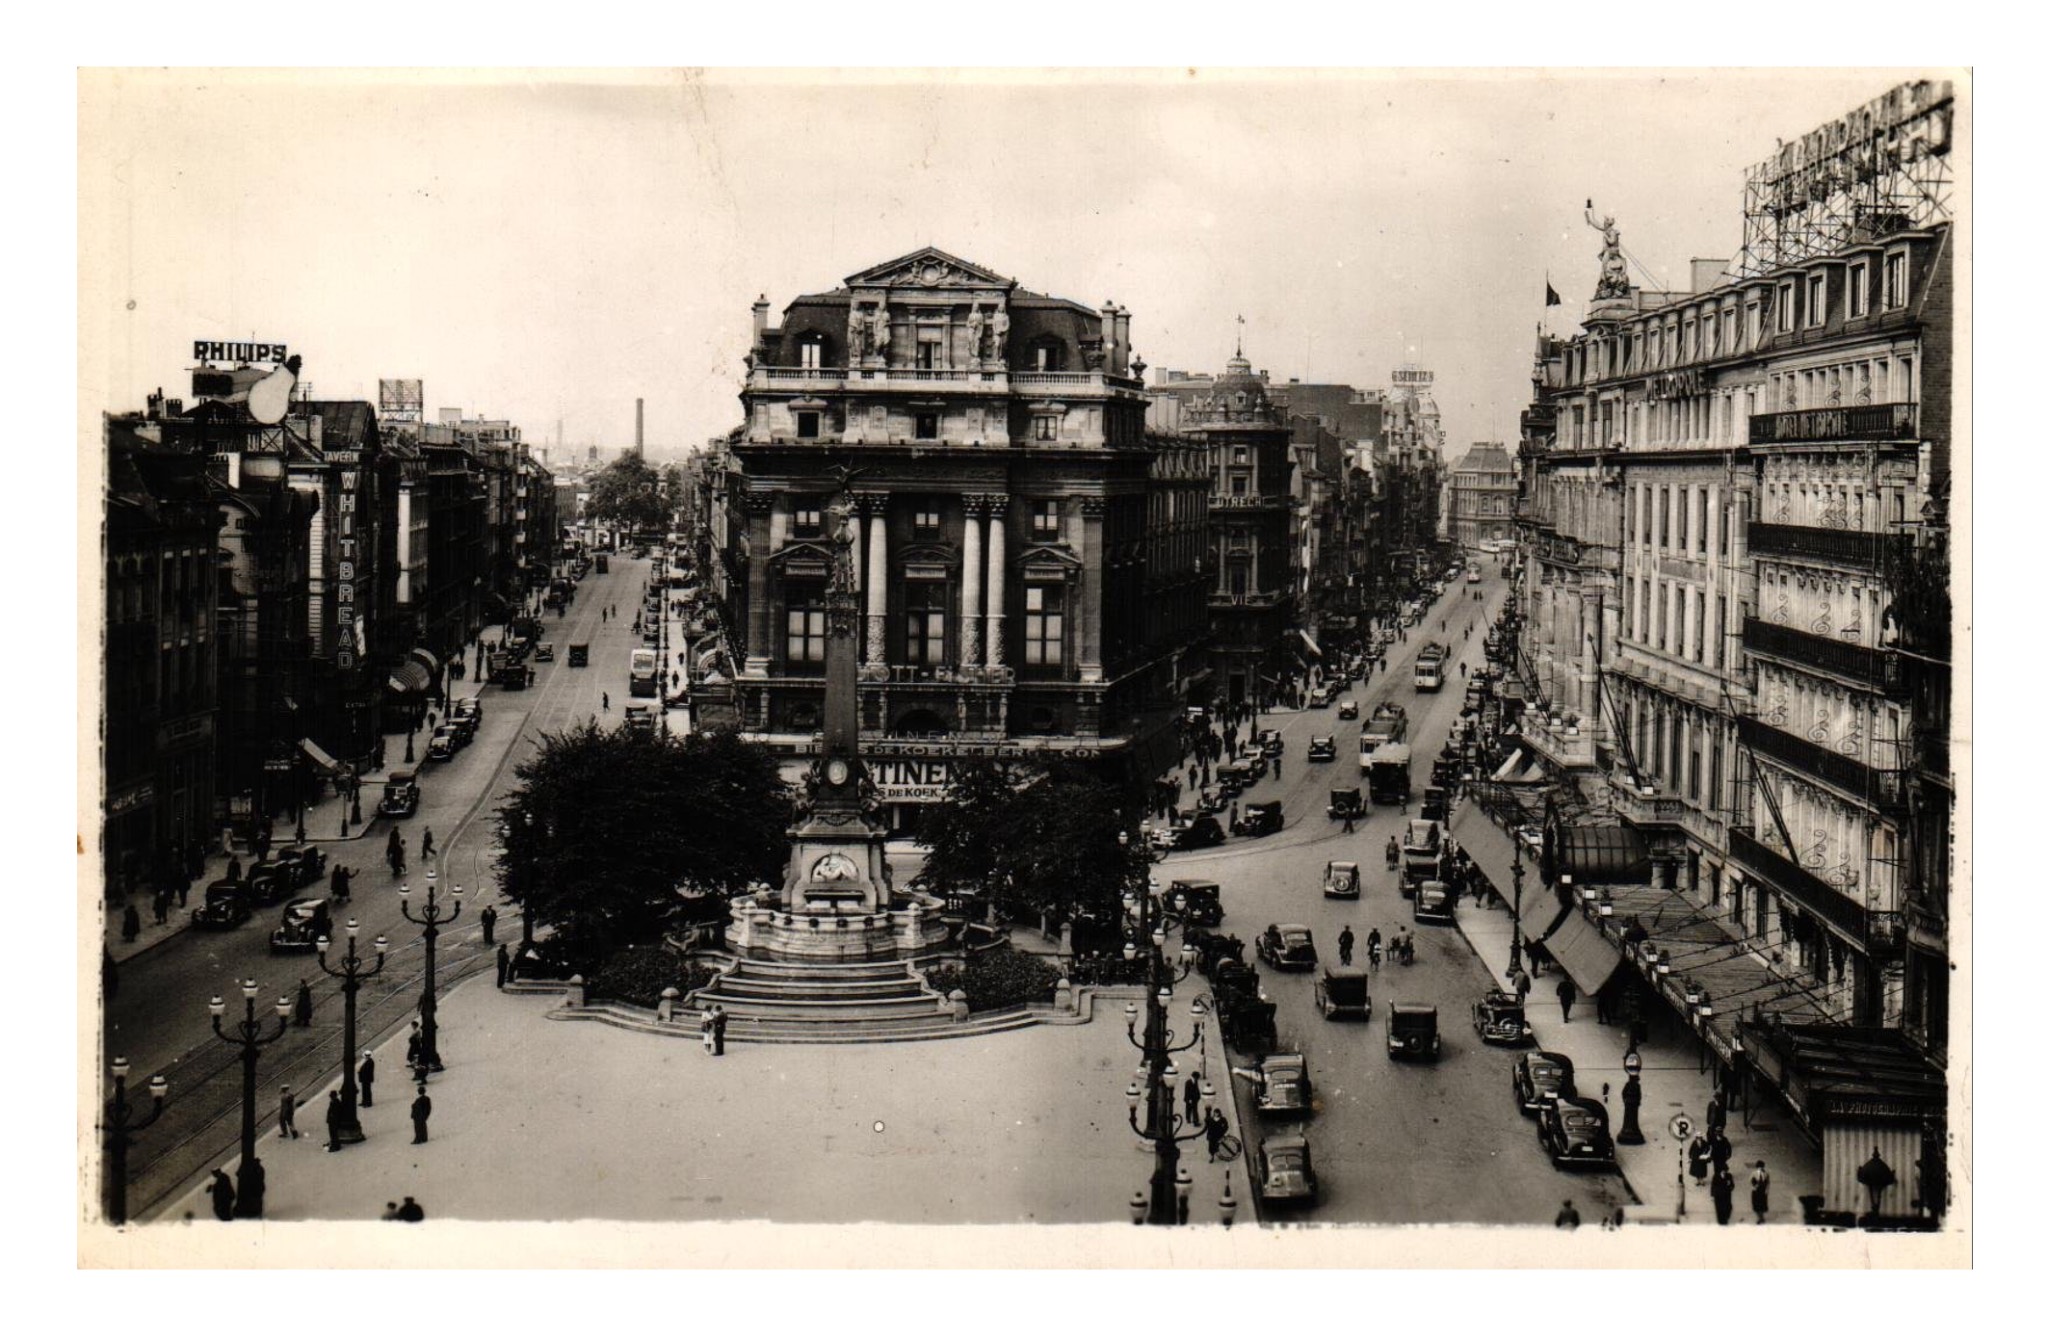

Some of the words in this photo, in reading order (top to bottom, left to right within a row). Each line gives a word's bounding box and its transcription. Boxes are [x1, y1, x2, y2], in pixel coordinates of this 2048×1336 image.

[194, 340, 287, 364] PHILIPS
[338, 471, 355, 670] WHITBREAD
[873, 745, 895, 755] DE
[888, 788, 903, 798] DE
